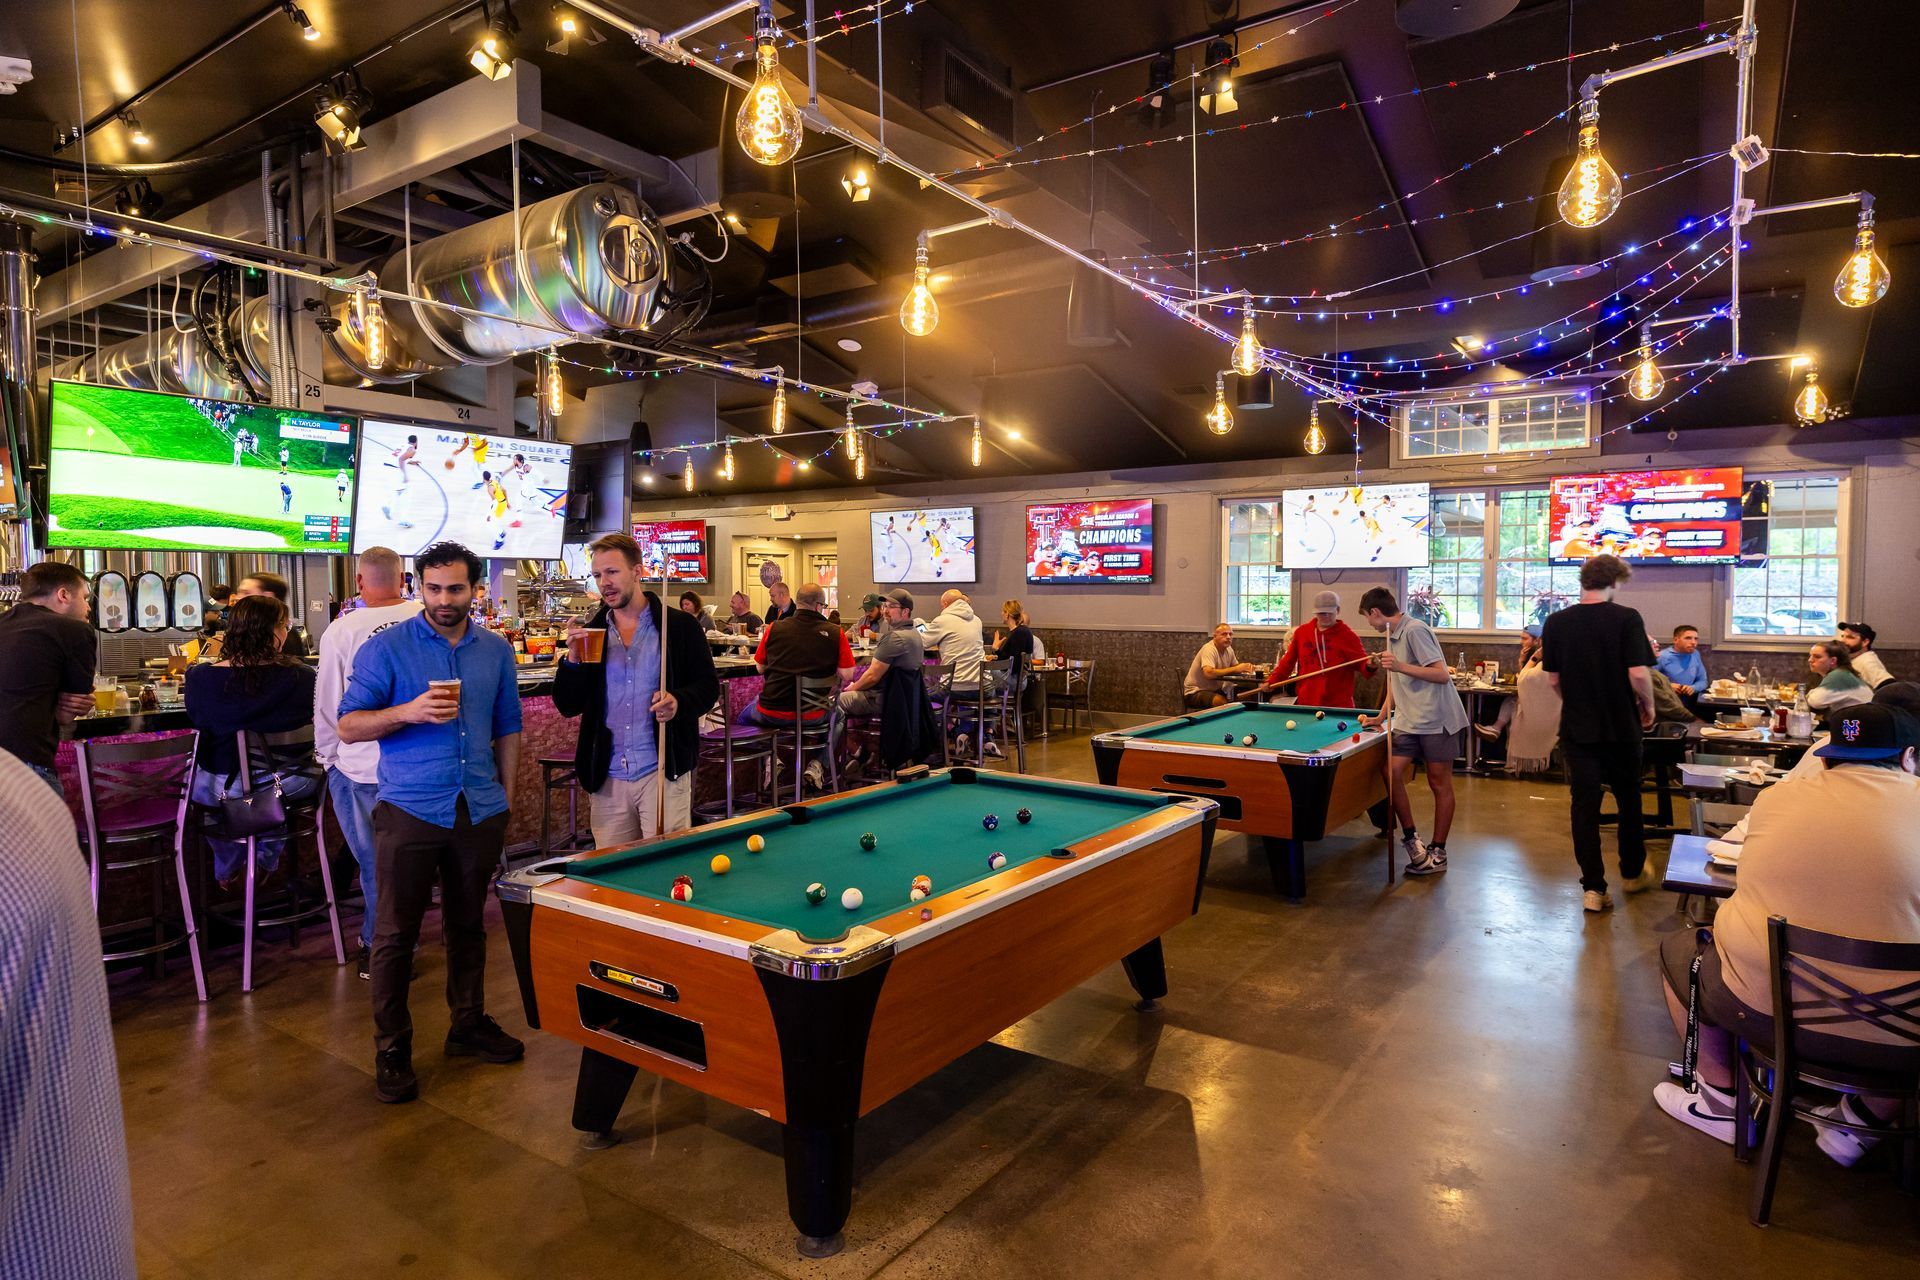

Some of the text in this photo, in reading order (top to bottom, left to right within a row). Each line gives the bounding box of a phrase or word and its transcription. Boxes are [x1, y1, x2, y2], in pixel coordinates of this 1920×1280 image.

[305, 384, 321, 397] 25
[457, 408, 471, 420] 24
[510, 443, 560, 455] SQUARE
[1080, 529, 1142, 544] CHAMPIONS
[1103, 554, 1140, 562] FIRST TIME
